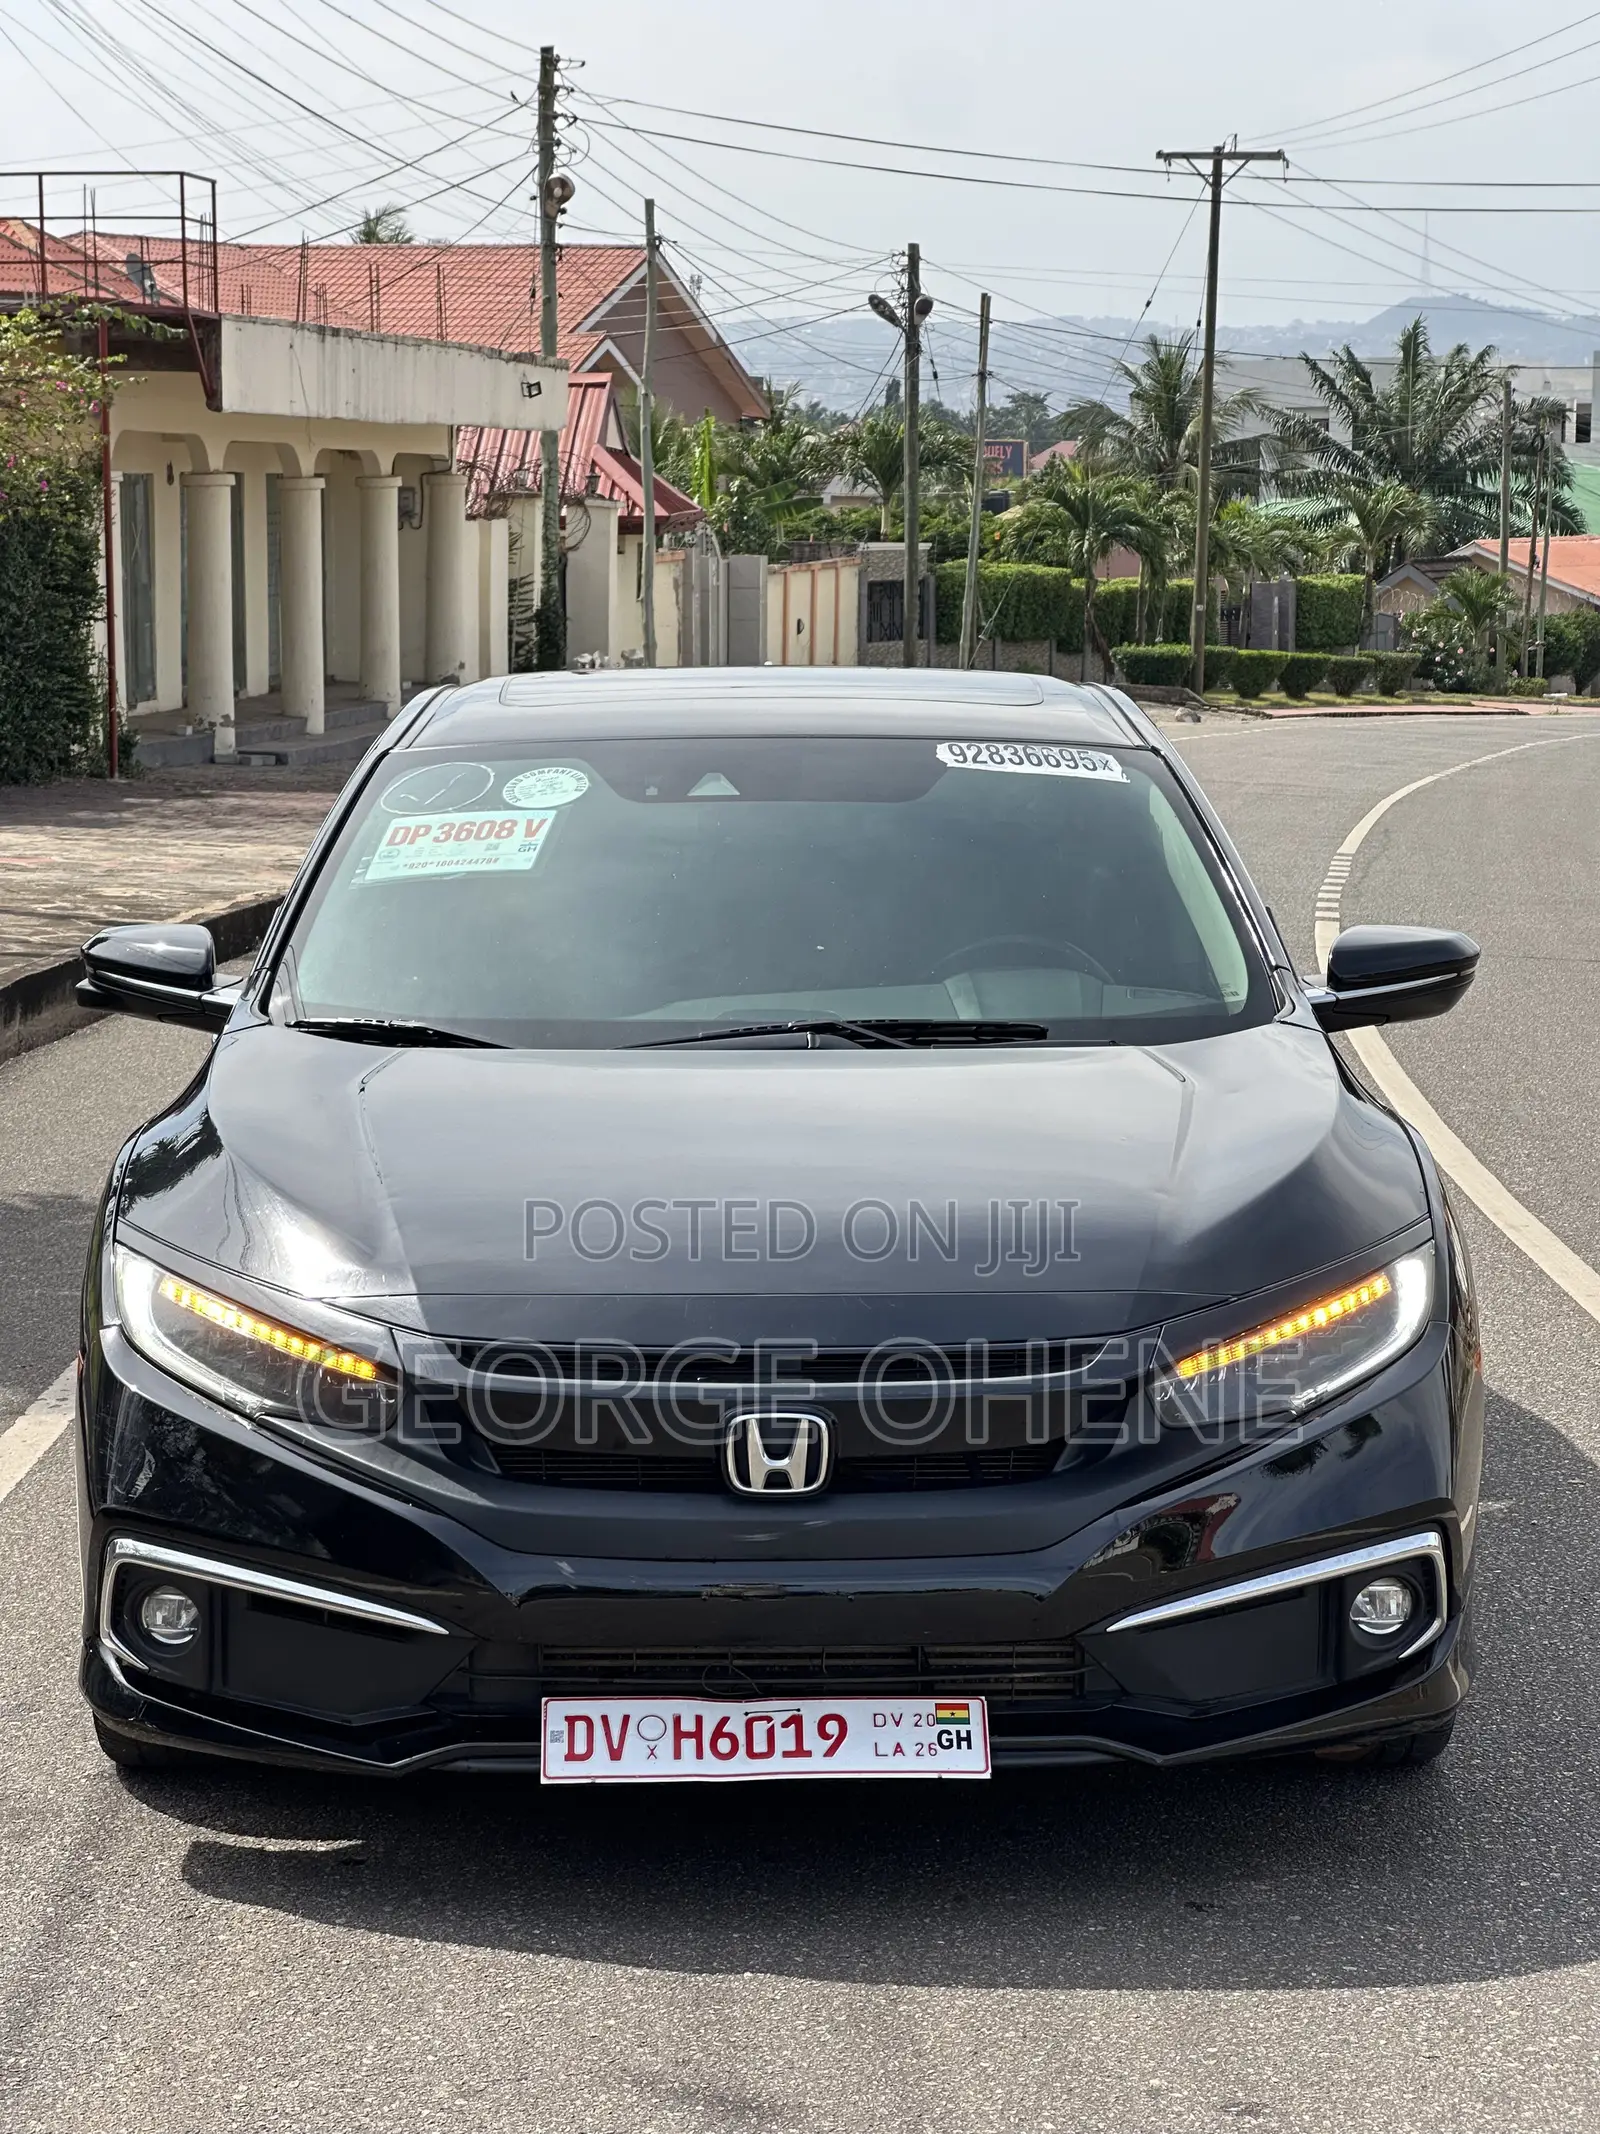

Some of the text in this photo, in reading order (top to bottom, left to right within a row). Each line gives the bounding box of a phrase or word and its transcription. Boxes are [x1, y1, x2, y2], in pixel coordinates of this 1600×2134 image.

[522, 768, 573, 779] COMPANY
[386, 818, 548, 846] DP 3608 V
[873, 1713, 936, 1728] DV 20
[564, 1714, 631, 1762] DV
[673, 1713, 848, 1761] H6019
[937, 1729, 972, 1750] GH
[874, 1742, 938, 1757] LA 26
